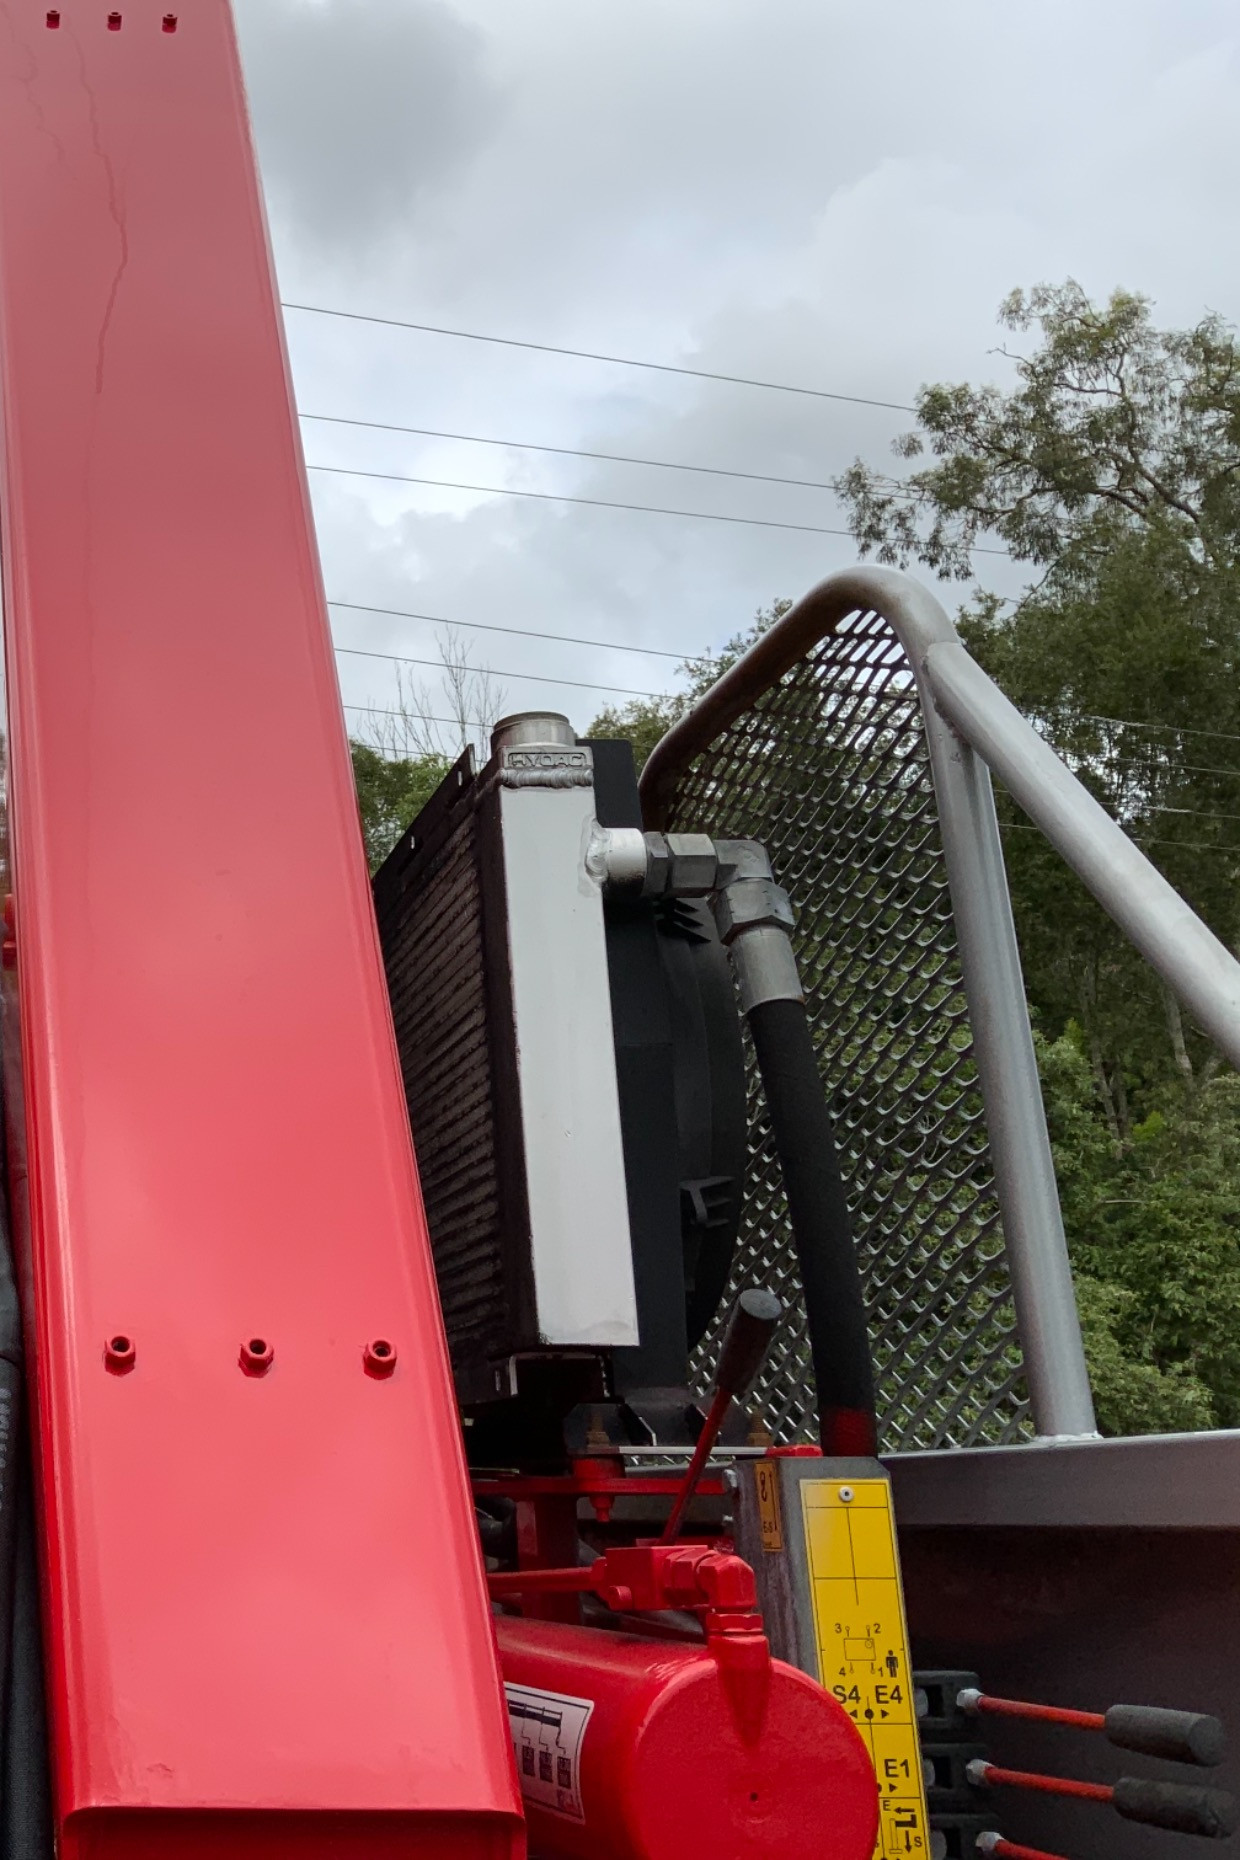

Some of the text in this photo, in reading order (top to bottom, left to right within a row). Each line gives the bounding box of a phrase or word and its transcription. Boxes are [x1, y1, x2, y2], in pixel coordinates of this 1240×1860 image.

[835, 1623, 881, 1634] 3 2
[839, 1667, 883, 1677] 4 1
[833, 1685, 903, 1704] S4 E4
[884, 1759, 909, 1778] E1
[883, 1800, 891, 1811] E
[914, 1836, 922, 1848] S
